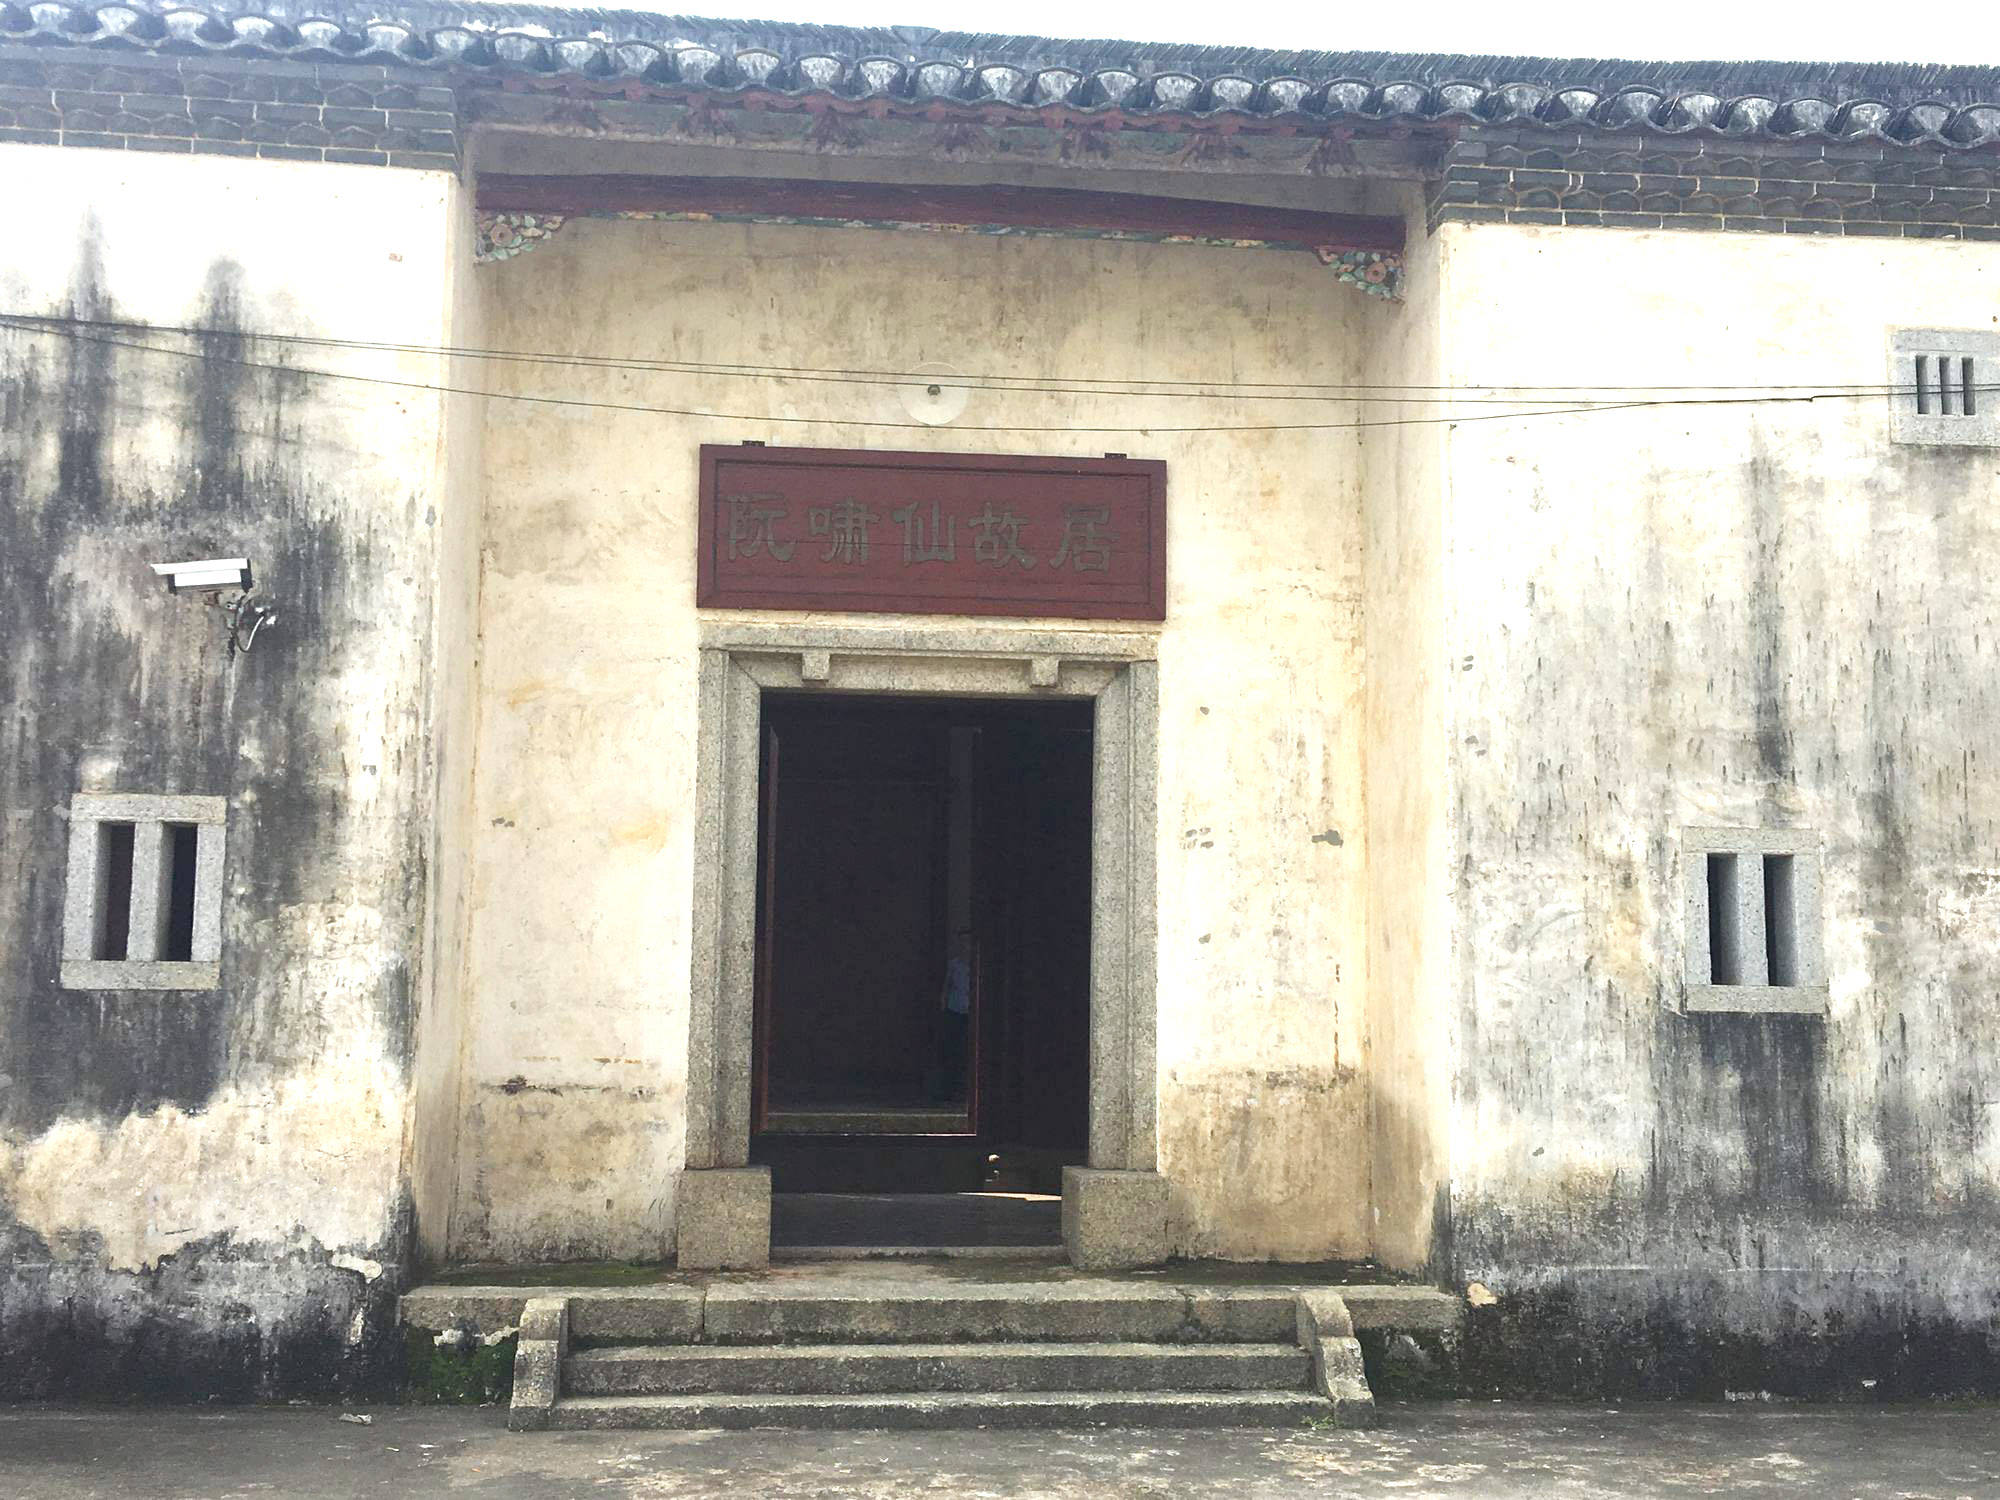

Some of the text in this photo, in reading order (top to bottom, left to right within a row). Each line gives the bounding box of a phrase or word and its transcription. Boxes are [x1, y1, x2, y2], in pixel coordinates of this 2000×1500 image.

[726, 492, 1116, 572] 阮啸仙故居
